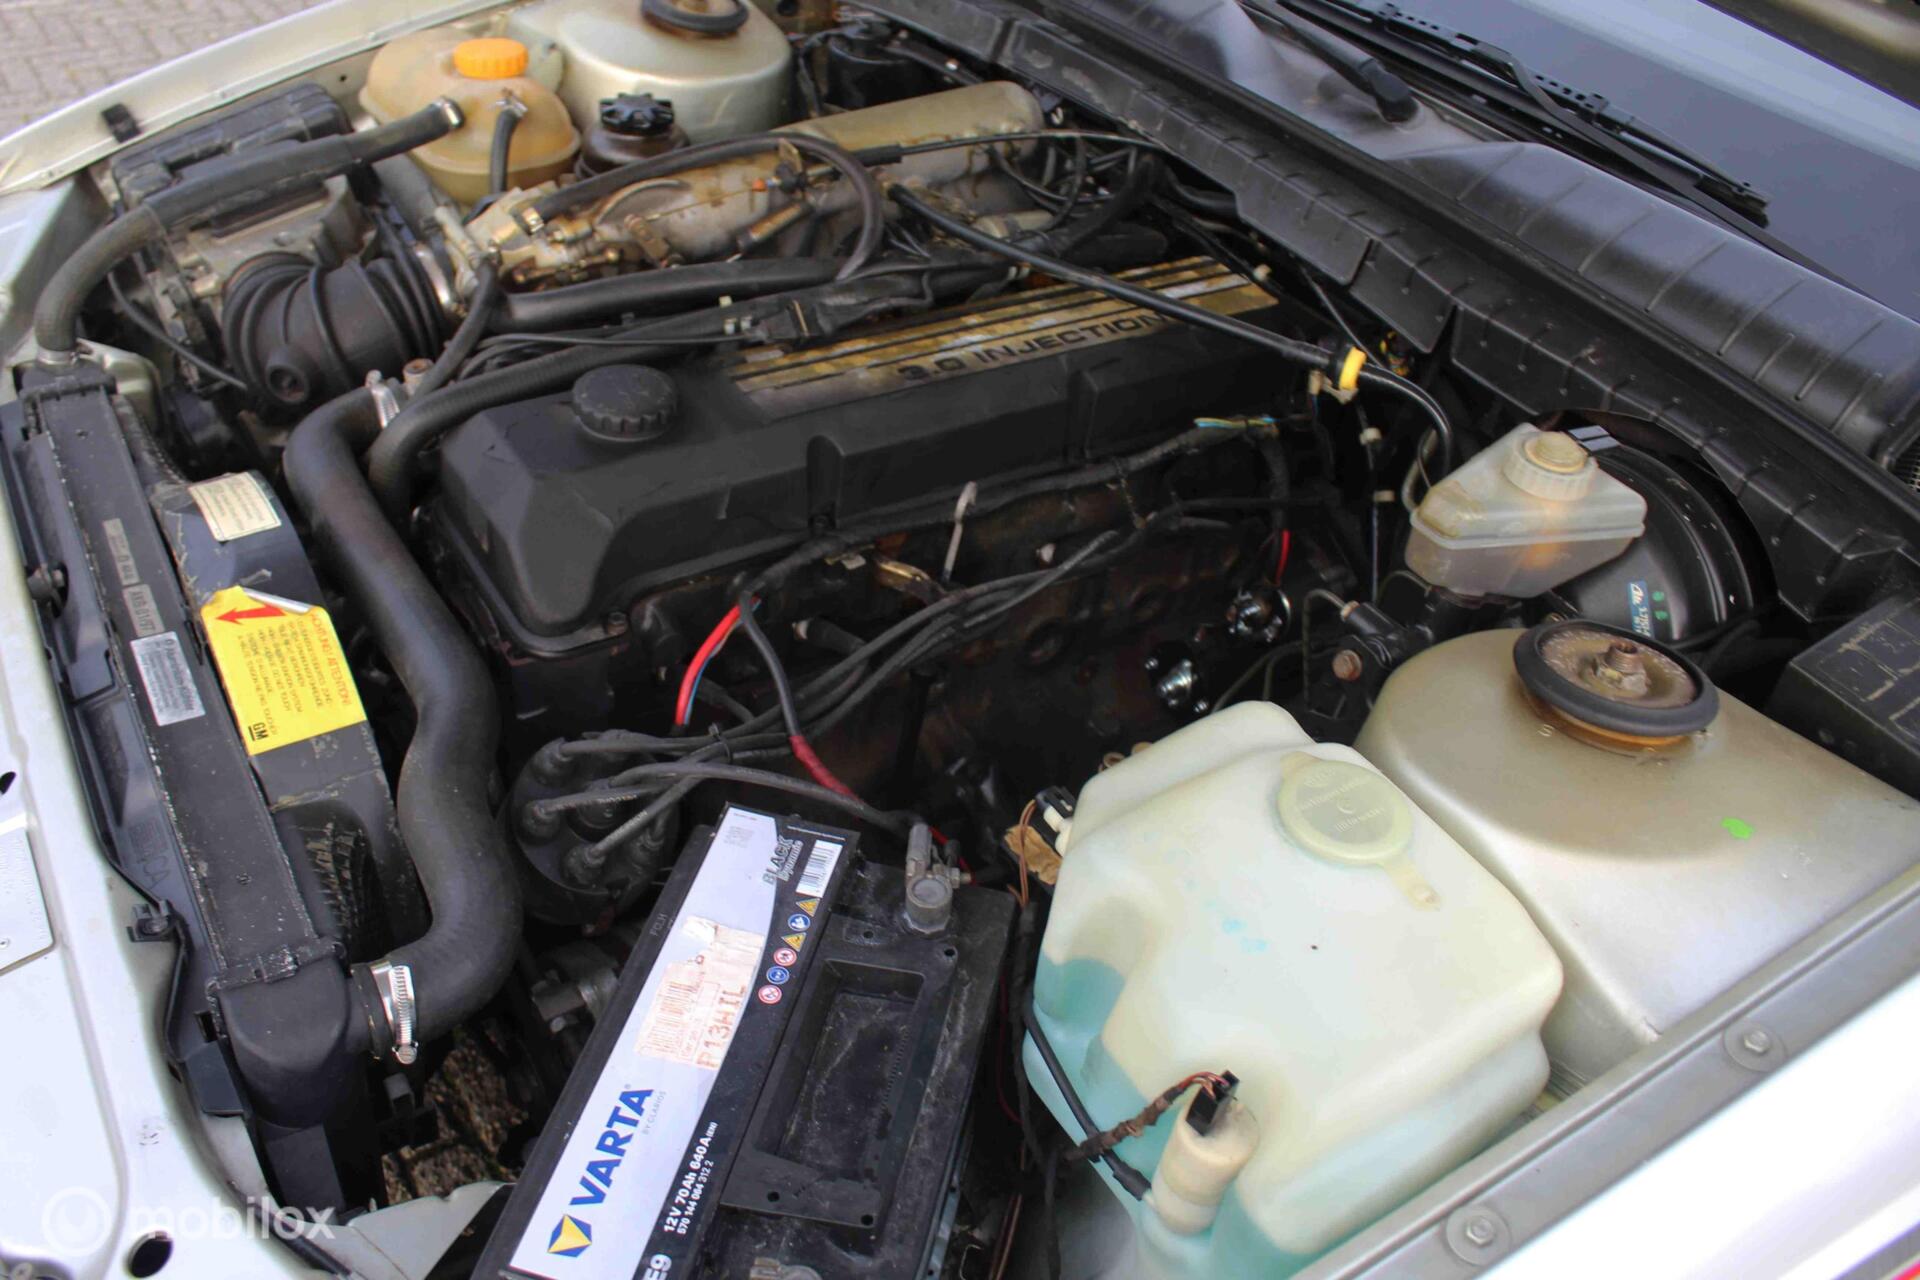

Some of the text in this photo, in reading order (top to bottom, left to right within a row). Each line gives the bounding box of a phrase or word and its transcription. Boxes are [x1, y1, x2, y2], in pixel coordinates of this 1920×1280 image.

[972, 311, 1171, 364] INJECTION
[250, 720, 270, 741] GM
[763, 835, 794, 885] BLACK
[647, 1091, 666, 1124] CLARIOS
[570, 1088, 654, 1206] VARTA
[663, 1206, 681, 1232] 12V
[674, 1172, 697, 1204] 70Ah
[676, 1217, 691, 1235] 570
[684, 1201, 698, 1216] 144
[698, 1167, 711, 1182] 312
